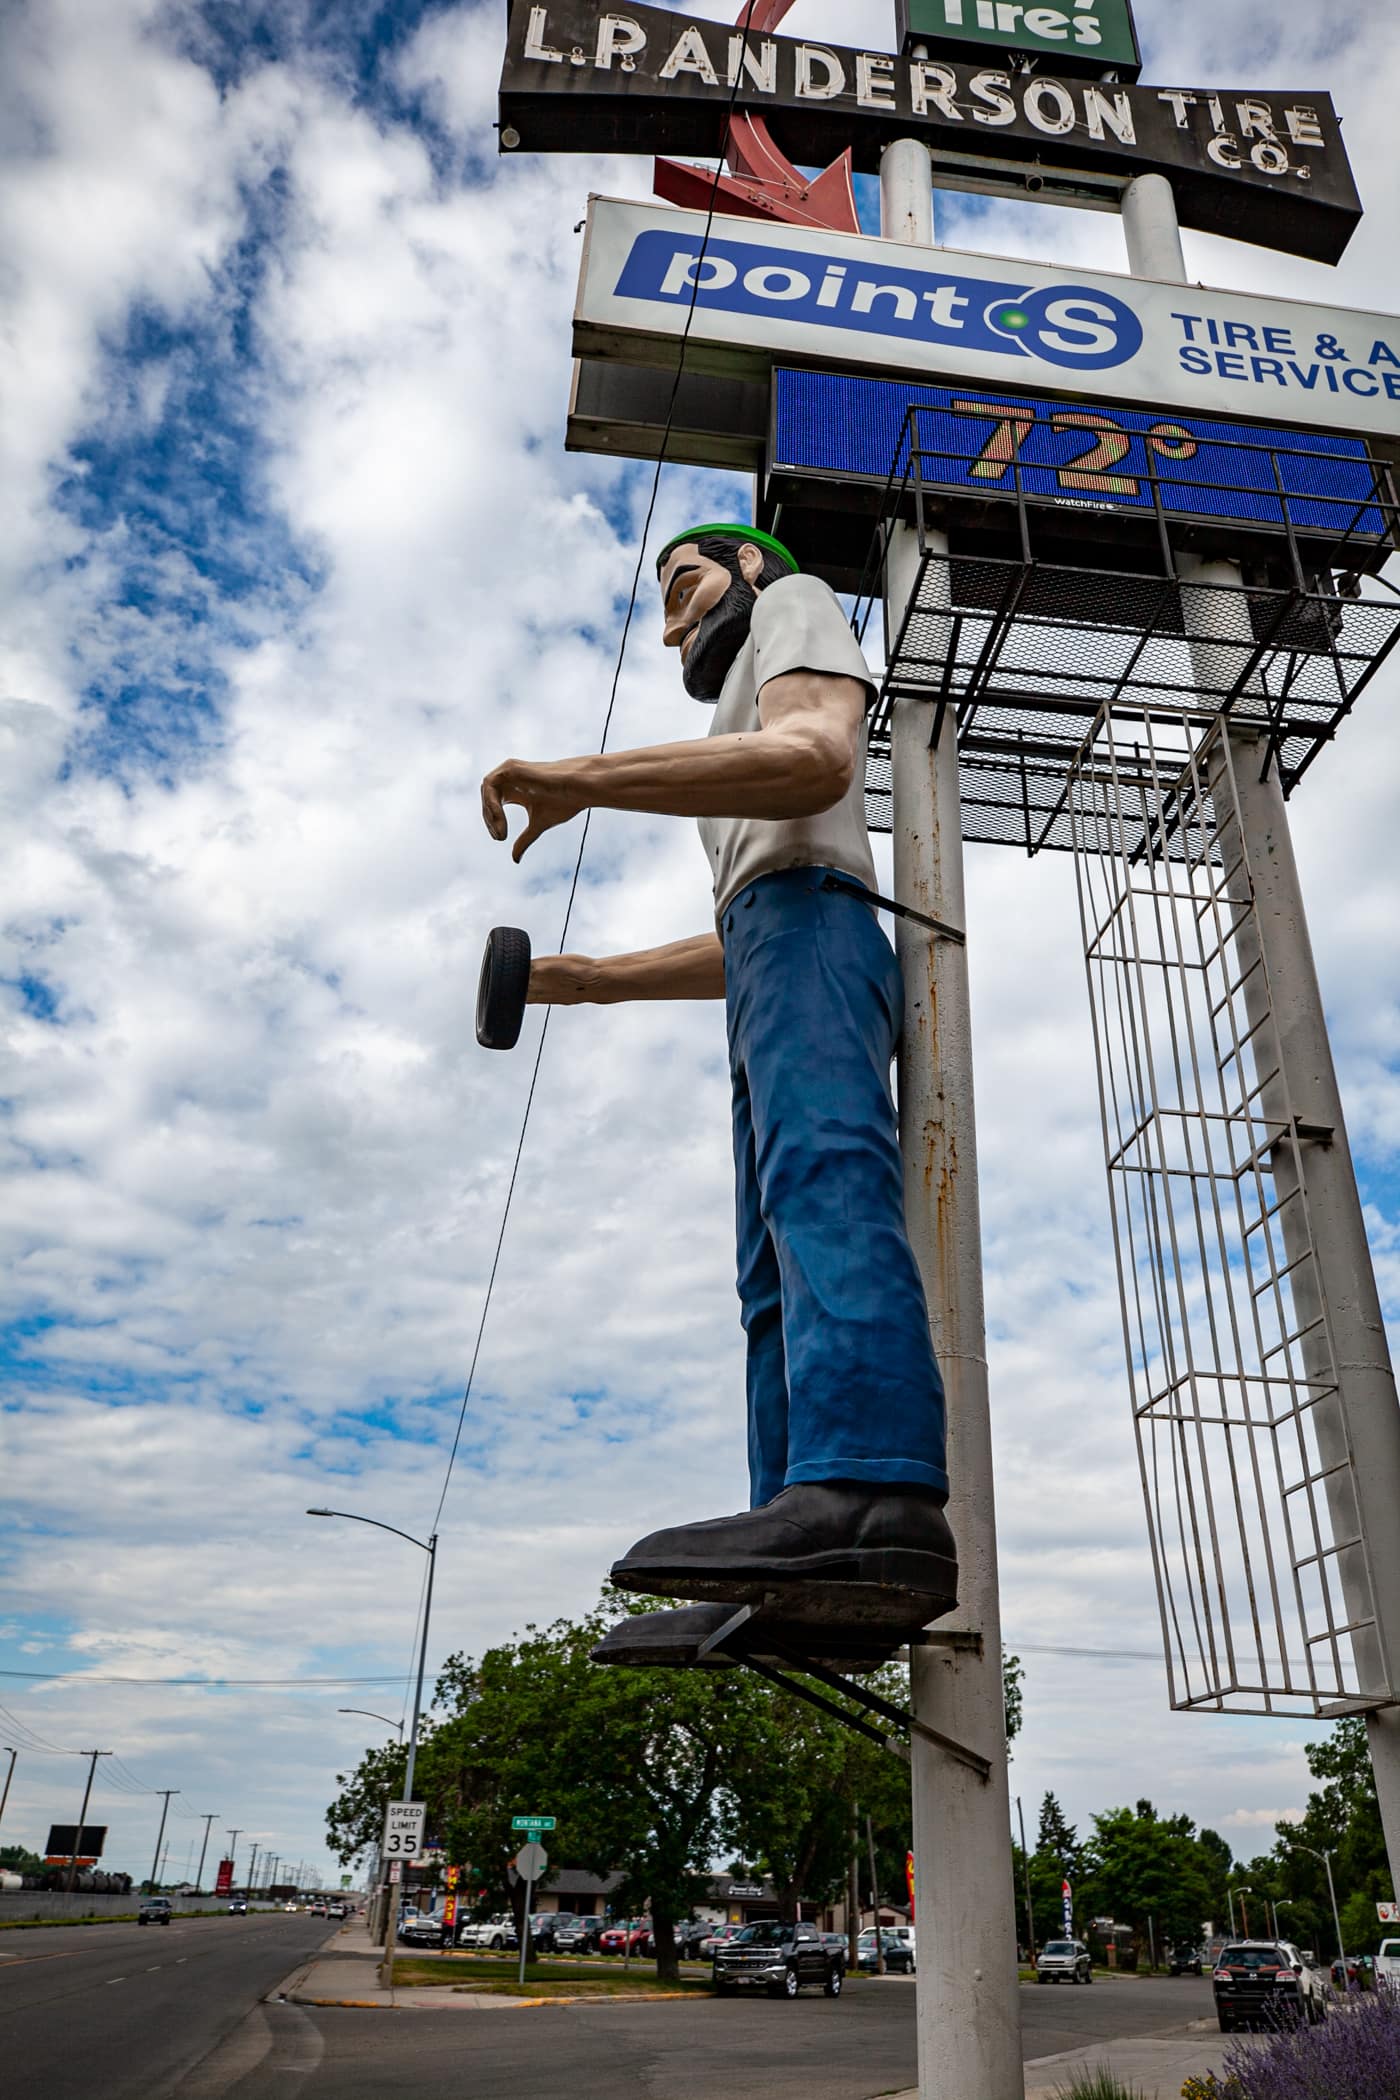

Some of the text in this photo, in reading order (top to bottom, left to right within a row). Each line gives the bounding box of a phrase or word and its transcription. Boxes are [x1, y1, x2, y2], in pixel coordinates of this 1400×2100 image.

[658, 26, 1137, 146] ANDERSON
[1157, 89, 1325, 147] TIRE
[1207, 132, 1311, 179] CO.
[660, 252, 1118, 355] point S
[1170, 312, 1296, 355] TIRE
[1314, 333, 1351, 362] &
[1179, 346, 1400, 400] SERVICE
[390, 1807, 423, 1817] SPEED
[391, 1820, 417, 1830] LIMIT
[387, 1834, 417, 1853] 35
